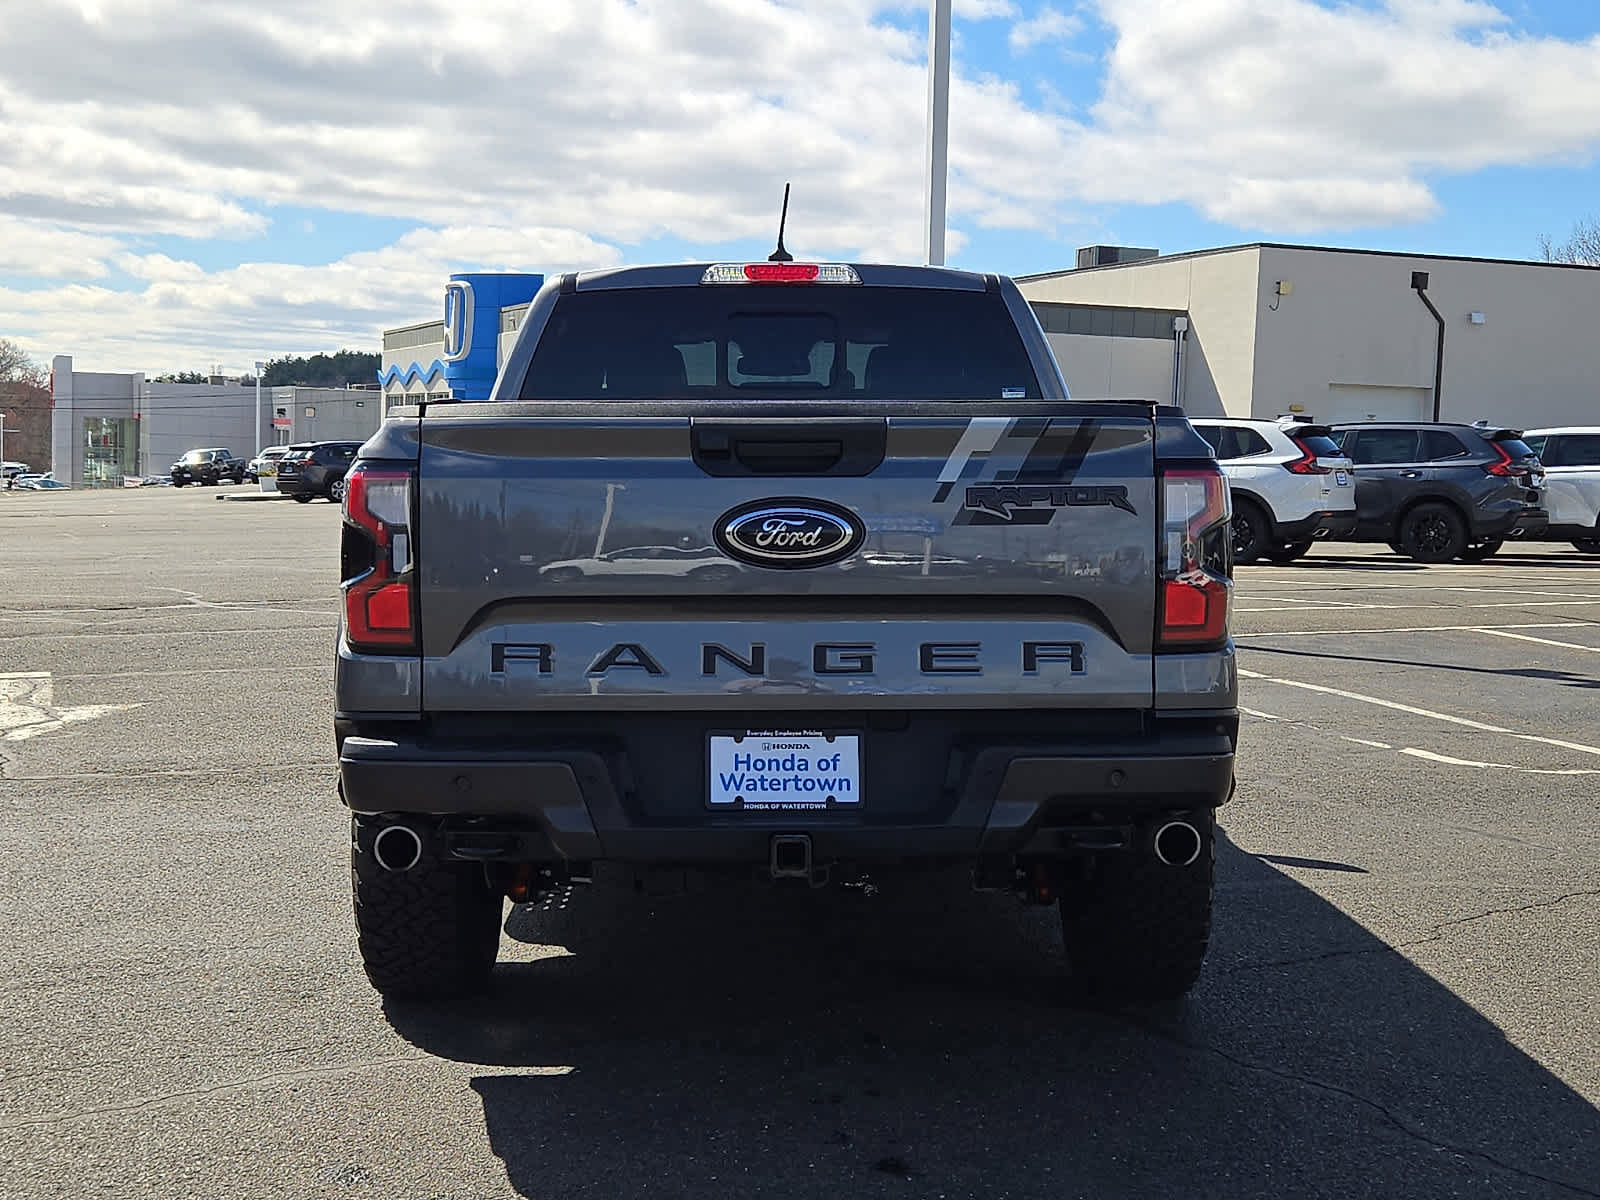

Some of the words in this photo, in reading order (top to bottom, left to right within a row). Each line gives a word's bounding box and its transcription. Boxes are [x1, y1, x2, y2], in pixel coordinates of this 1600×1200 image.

[965, 486, 1138, 516] RAPTOR
[756, 518, 823, 546] Ford
[490, 642, 1088, 676] RANGER
[734, 753, 809, 772] Honda
[816, 753, 841, 772] of
[719, 772, 851, 792] Watertown
